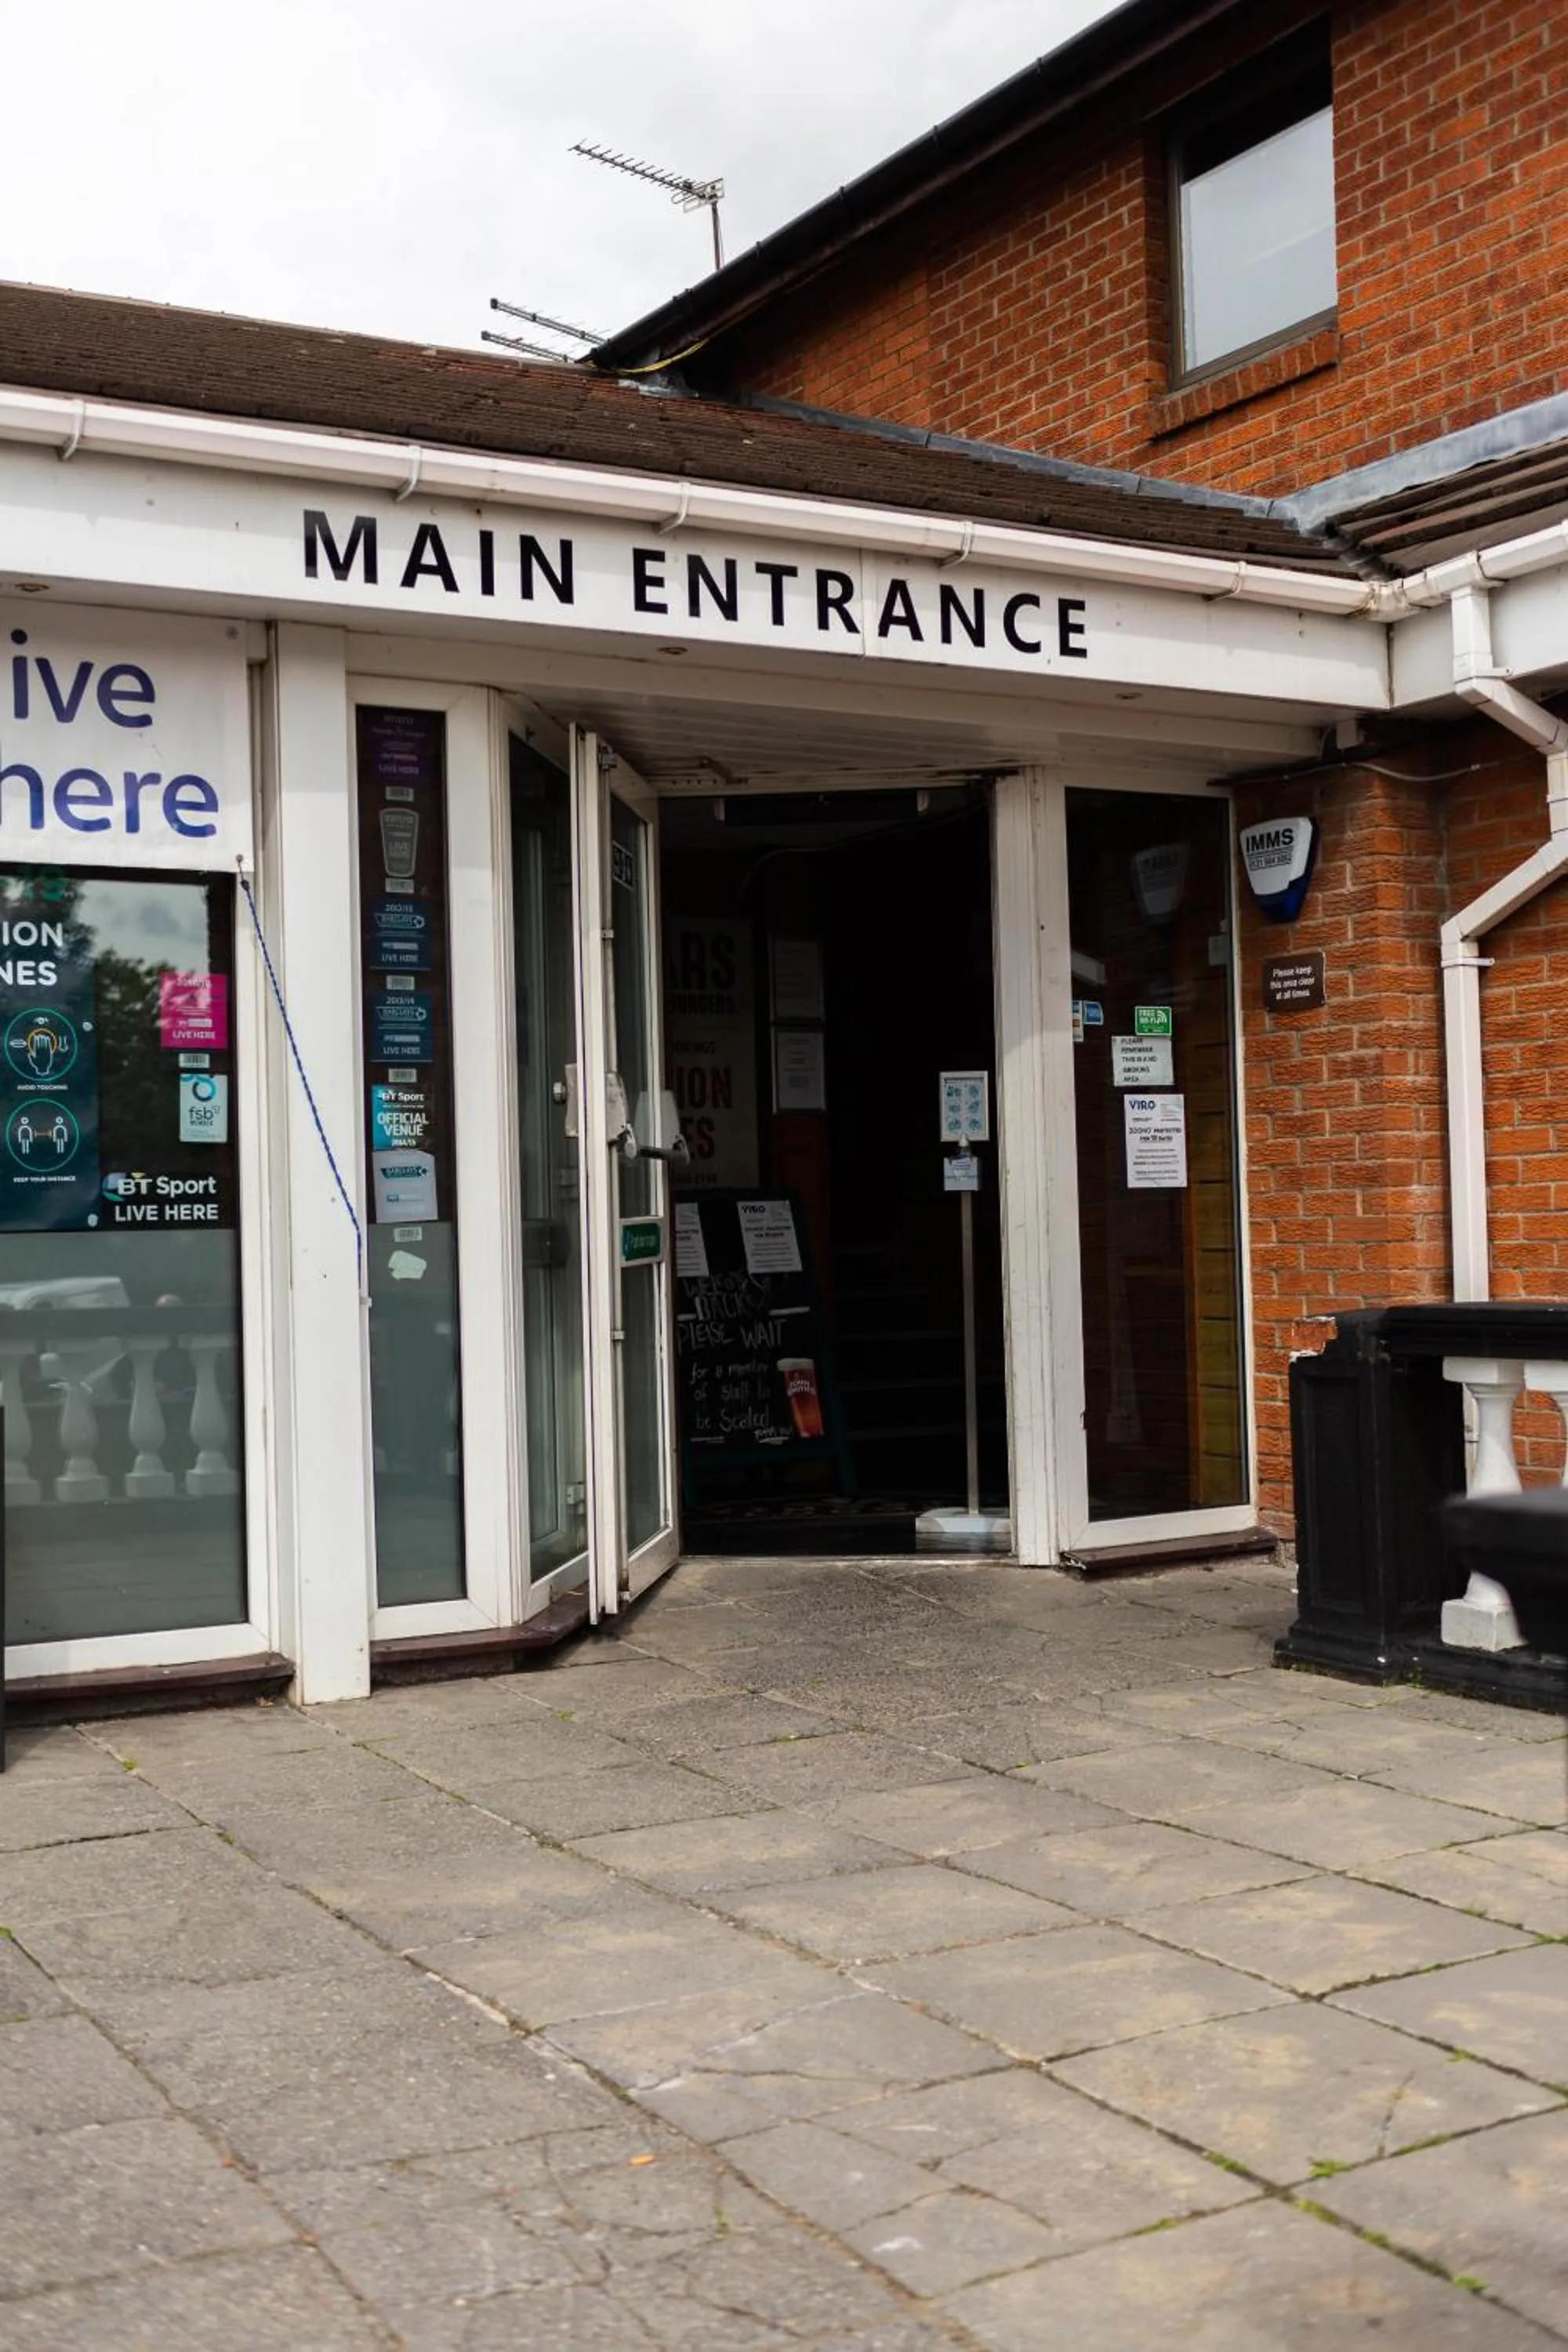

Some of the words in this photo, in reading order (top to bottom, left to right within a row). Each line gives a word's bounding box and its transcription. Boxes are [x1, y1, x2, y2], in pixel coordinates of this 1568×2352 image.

[303, 510, 574, 604] MAIN
[632, 546, 1087, 658] ENTRANCE
[1245, 828, 1294, 853] IMMS
[2, 920, 63, 947] ION
[1273, 968, 1294, 978] Please
[1296, 965, 1312, 976] keep
[398, 1092, 425, 1102] Sport
[188, 1106, 214, 1120] fsb
[1129, 1100, 1156, 1111] VIRO
[377, 1112, 430, 1124] OFFICIAL
[383, 1124, 424, 1136] VENUE
[118, 1178, 152, 1195] BT
[156, 1176, 217, 1198] Sport
[115, 1205, 158, 1221] LIVE
[165, 1203, 219, 1221] HERE
[739, 1318, 788, 1350] WAIT
